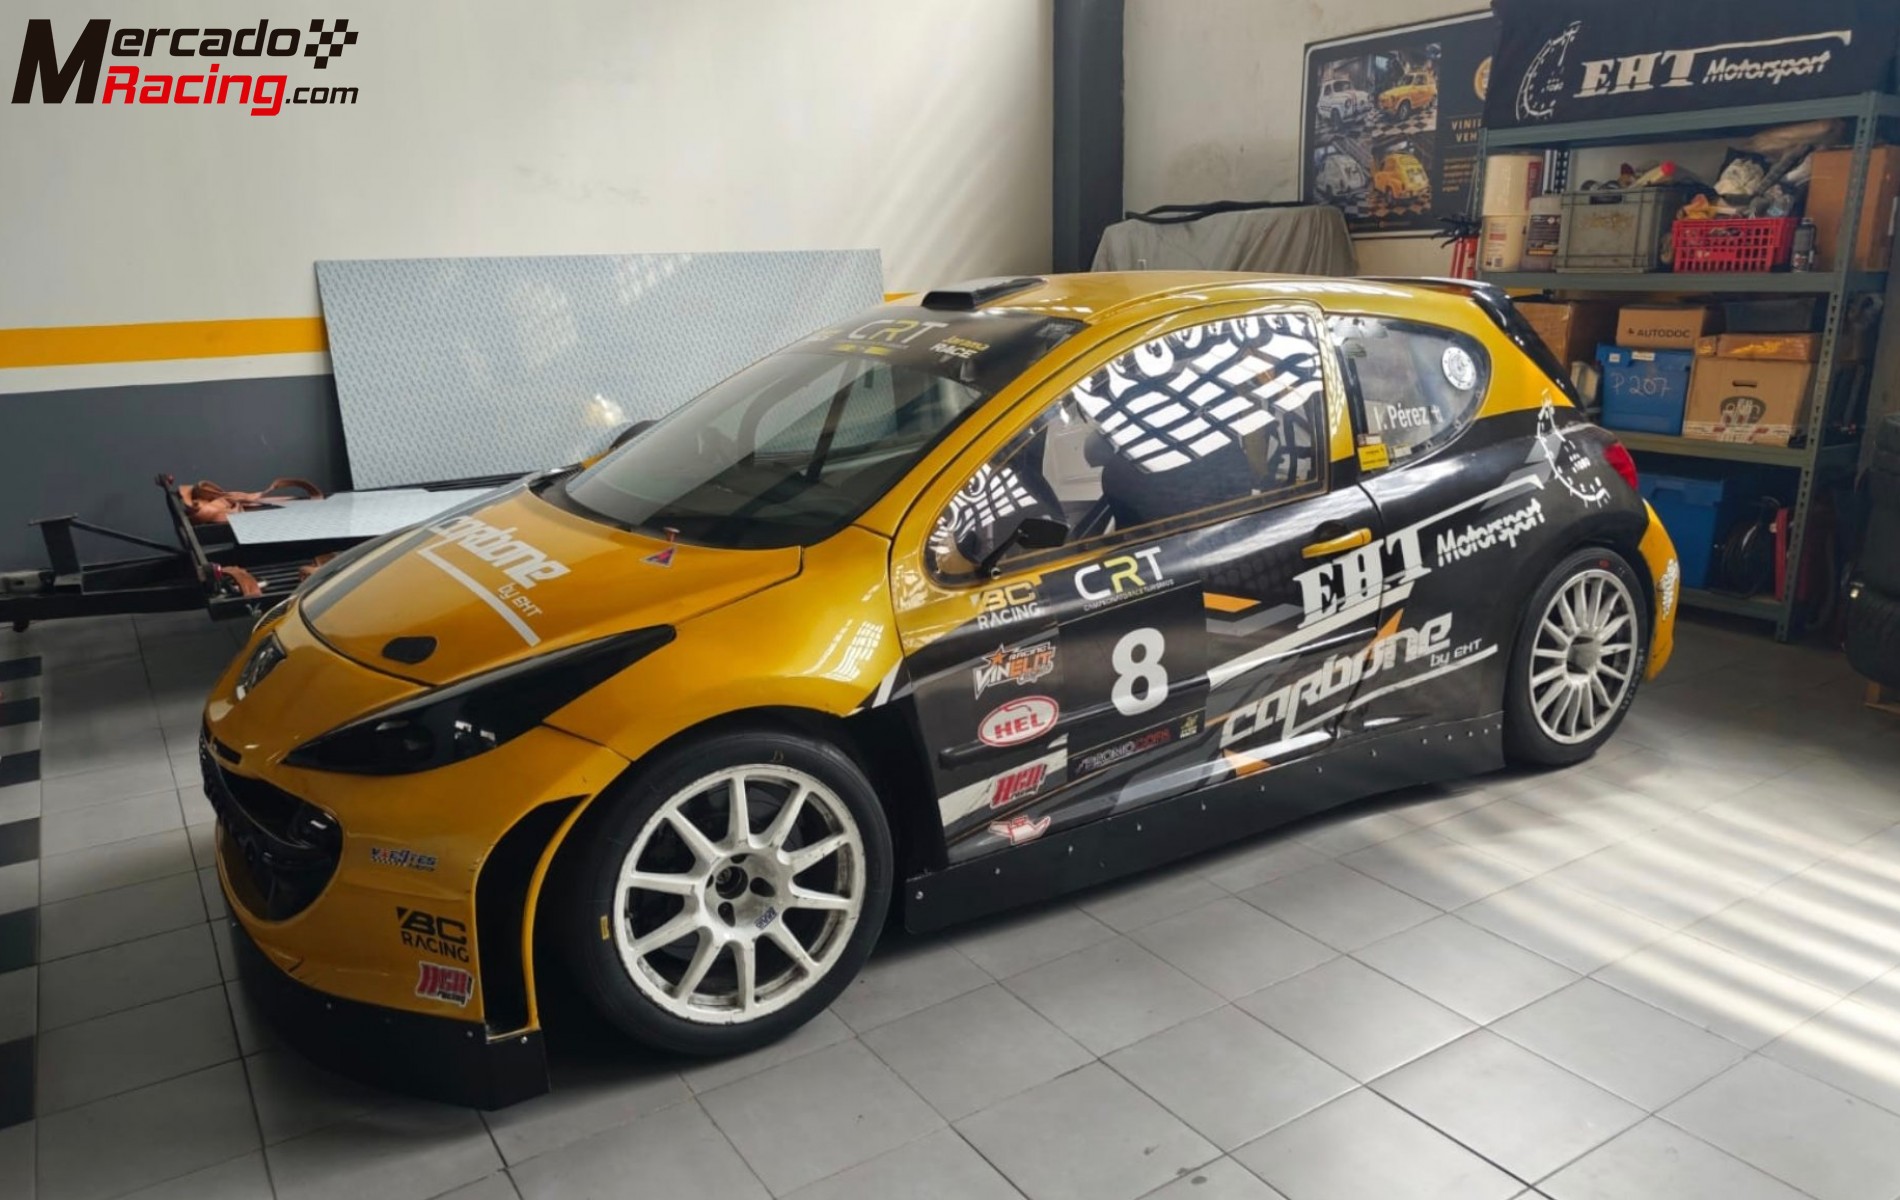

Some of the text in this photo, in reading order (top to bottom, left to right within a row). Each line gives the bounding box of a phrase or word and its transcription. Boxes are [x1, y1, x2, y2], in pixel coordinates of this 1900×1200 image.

[1573, 50, 1831, 98] EHT Motorsport
[848, 319, 949, 343] CRT
[1637, 328, 1691, 339] AUTODOC
[1630, 375, 1671, 396] 207
[1387, 402, 1429, 429] Pérez
[1436, 498, 1546, 567] Motorsport
[1074, 546, 1164, 601] CRT
[1292, 524, 1432, 629] EHT
[977, 602, 1041, 630] RACING
[1111, 627, 1168, 717] 8
[1430, 651, 1450, 667] by
[994, 714, 1045, 739] HEL
[401, 910, 467, 945] BC
[401, 930, 469, 962] RACING
